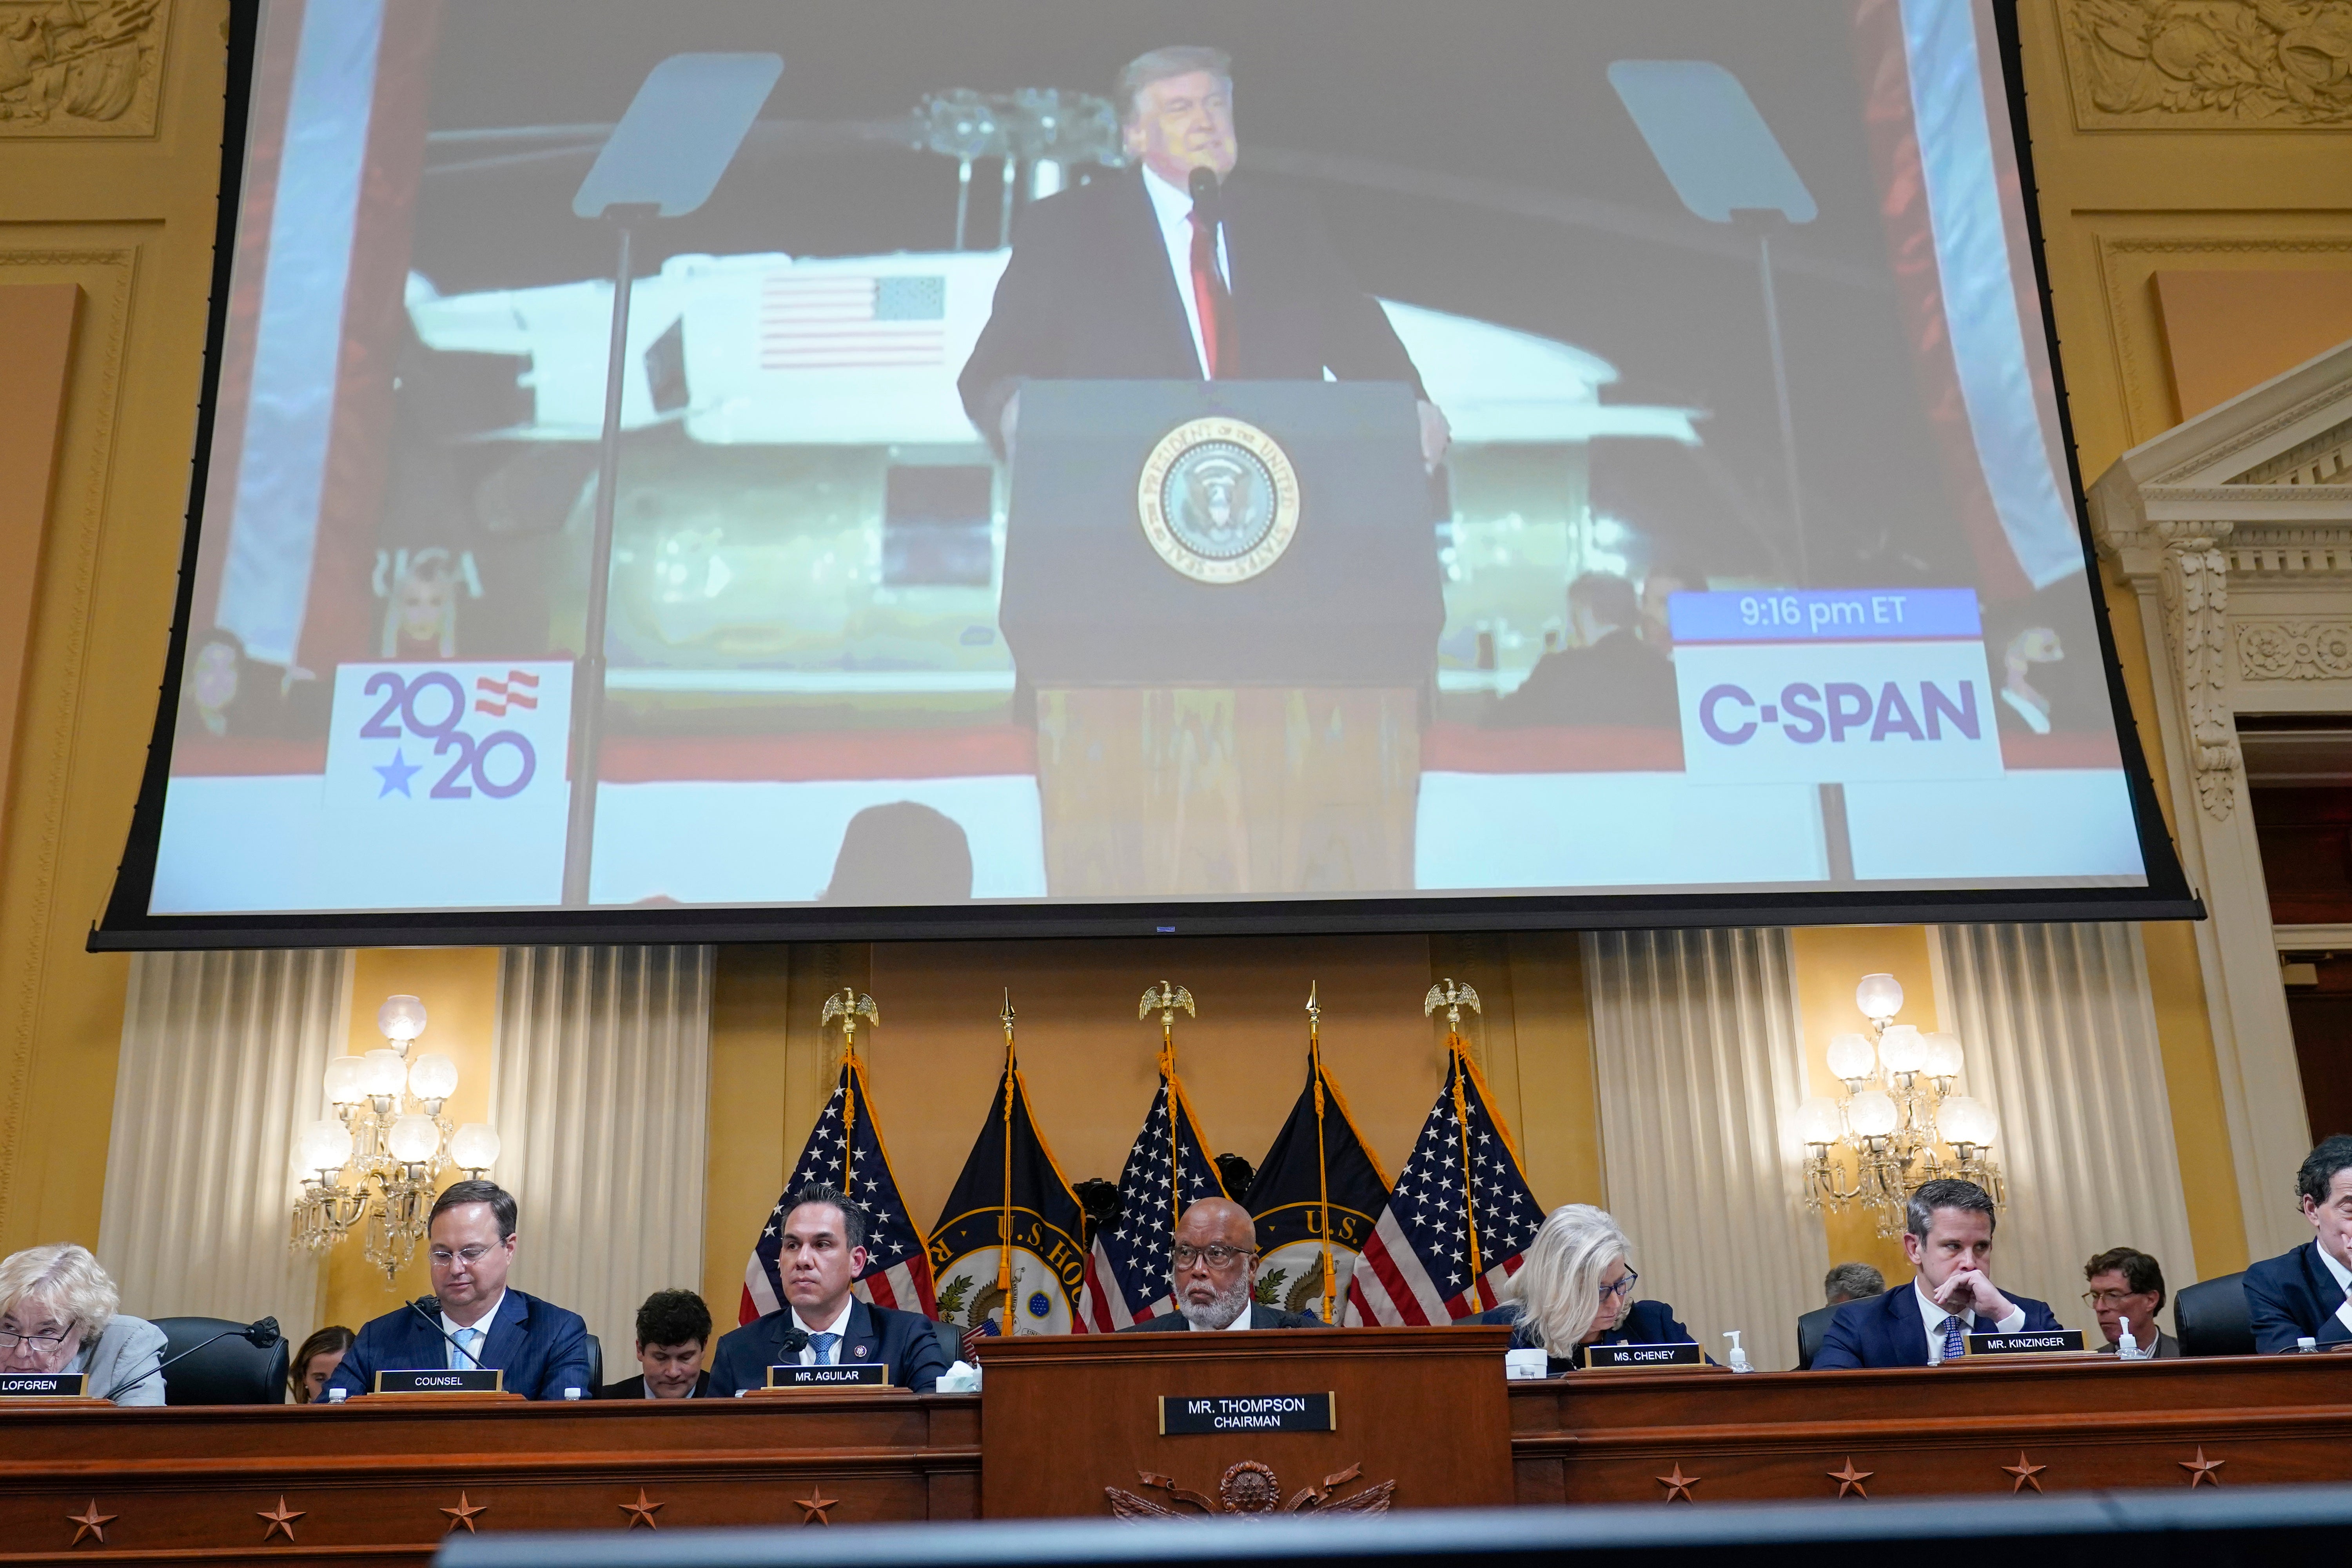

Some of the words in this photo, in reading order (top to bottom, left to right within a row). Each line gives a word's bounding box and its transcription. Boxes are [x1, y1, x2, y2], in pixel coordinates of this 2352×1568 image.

[1740, 596, 1801, 626] 9:16
[1809, 600, 1865, 633] pm
[1872, 596, 1907, 623] ET
[1699, 680, 1981, 746] C-SPAN
[1987, 1340, 2007, 1349] MR.
[2009, 1337, 2065, 1348] KINZINGER
[1614, 1352, 1632, 1361] MS.
[1634, 1350, 1675, 1361] CHENEY
[415, 1377, 463, 1386] COUNSEL
[795, 1372, 813, 1381] MR.
[815, 1370, 859, 1381] AGUILAR
[2, 1380, 57, 1390] LOFGREN
[1188, 1400, 1215, 1414] MR.
[1219, 1397, 1305, 1413] THOMPSON
[1214, 1415, 1281, 1428] CHAIRMAN
